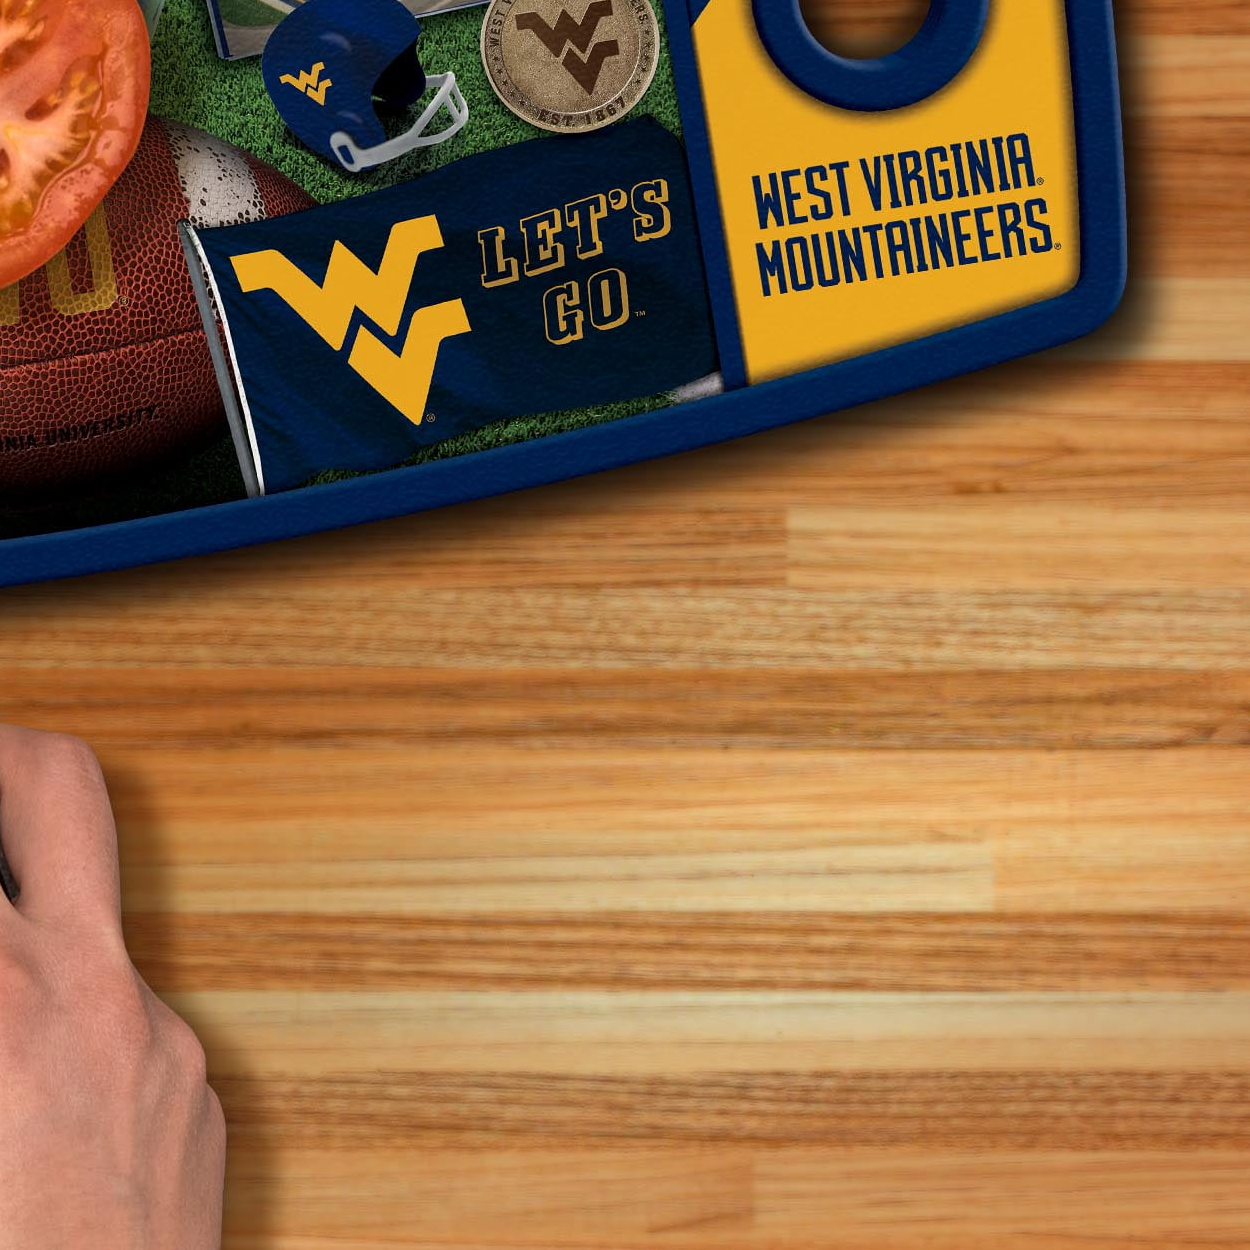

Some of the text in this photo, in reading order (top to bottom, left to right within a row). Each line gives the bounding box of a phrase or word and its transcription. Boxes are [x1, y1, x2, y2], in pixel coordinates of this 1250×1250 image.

[489, 10, 508, 47] WEST
[581, 97, 626, 125] 1867
[751, 132, 1036, 230] WEST VIRGINIA
[477, 178, 672, 289] LET'S
[755, 197, 1053, 297] MOUNTAINEERS
[542, 268, 630, 345] GO
[45, 405, 160, 447] UNIVERSITY
